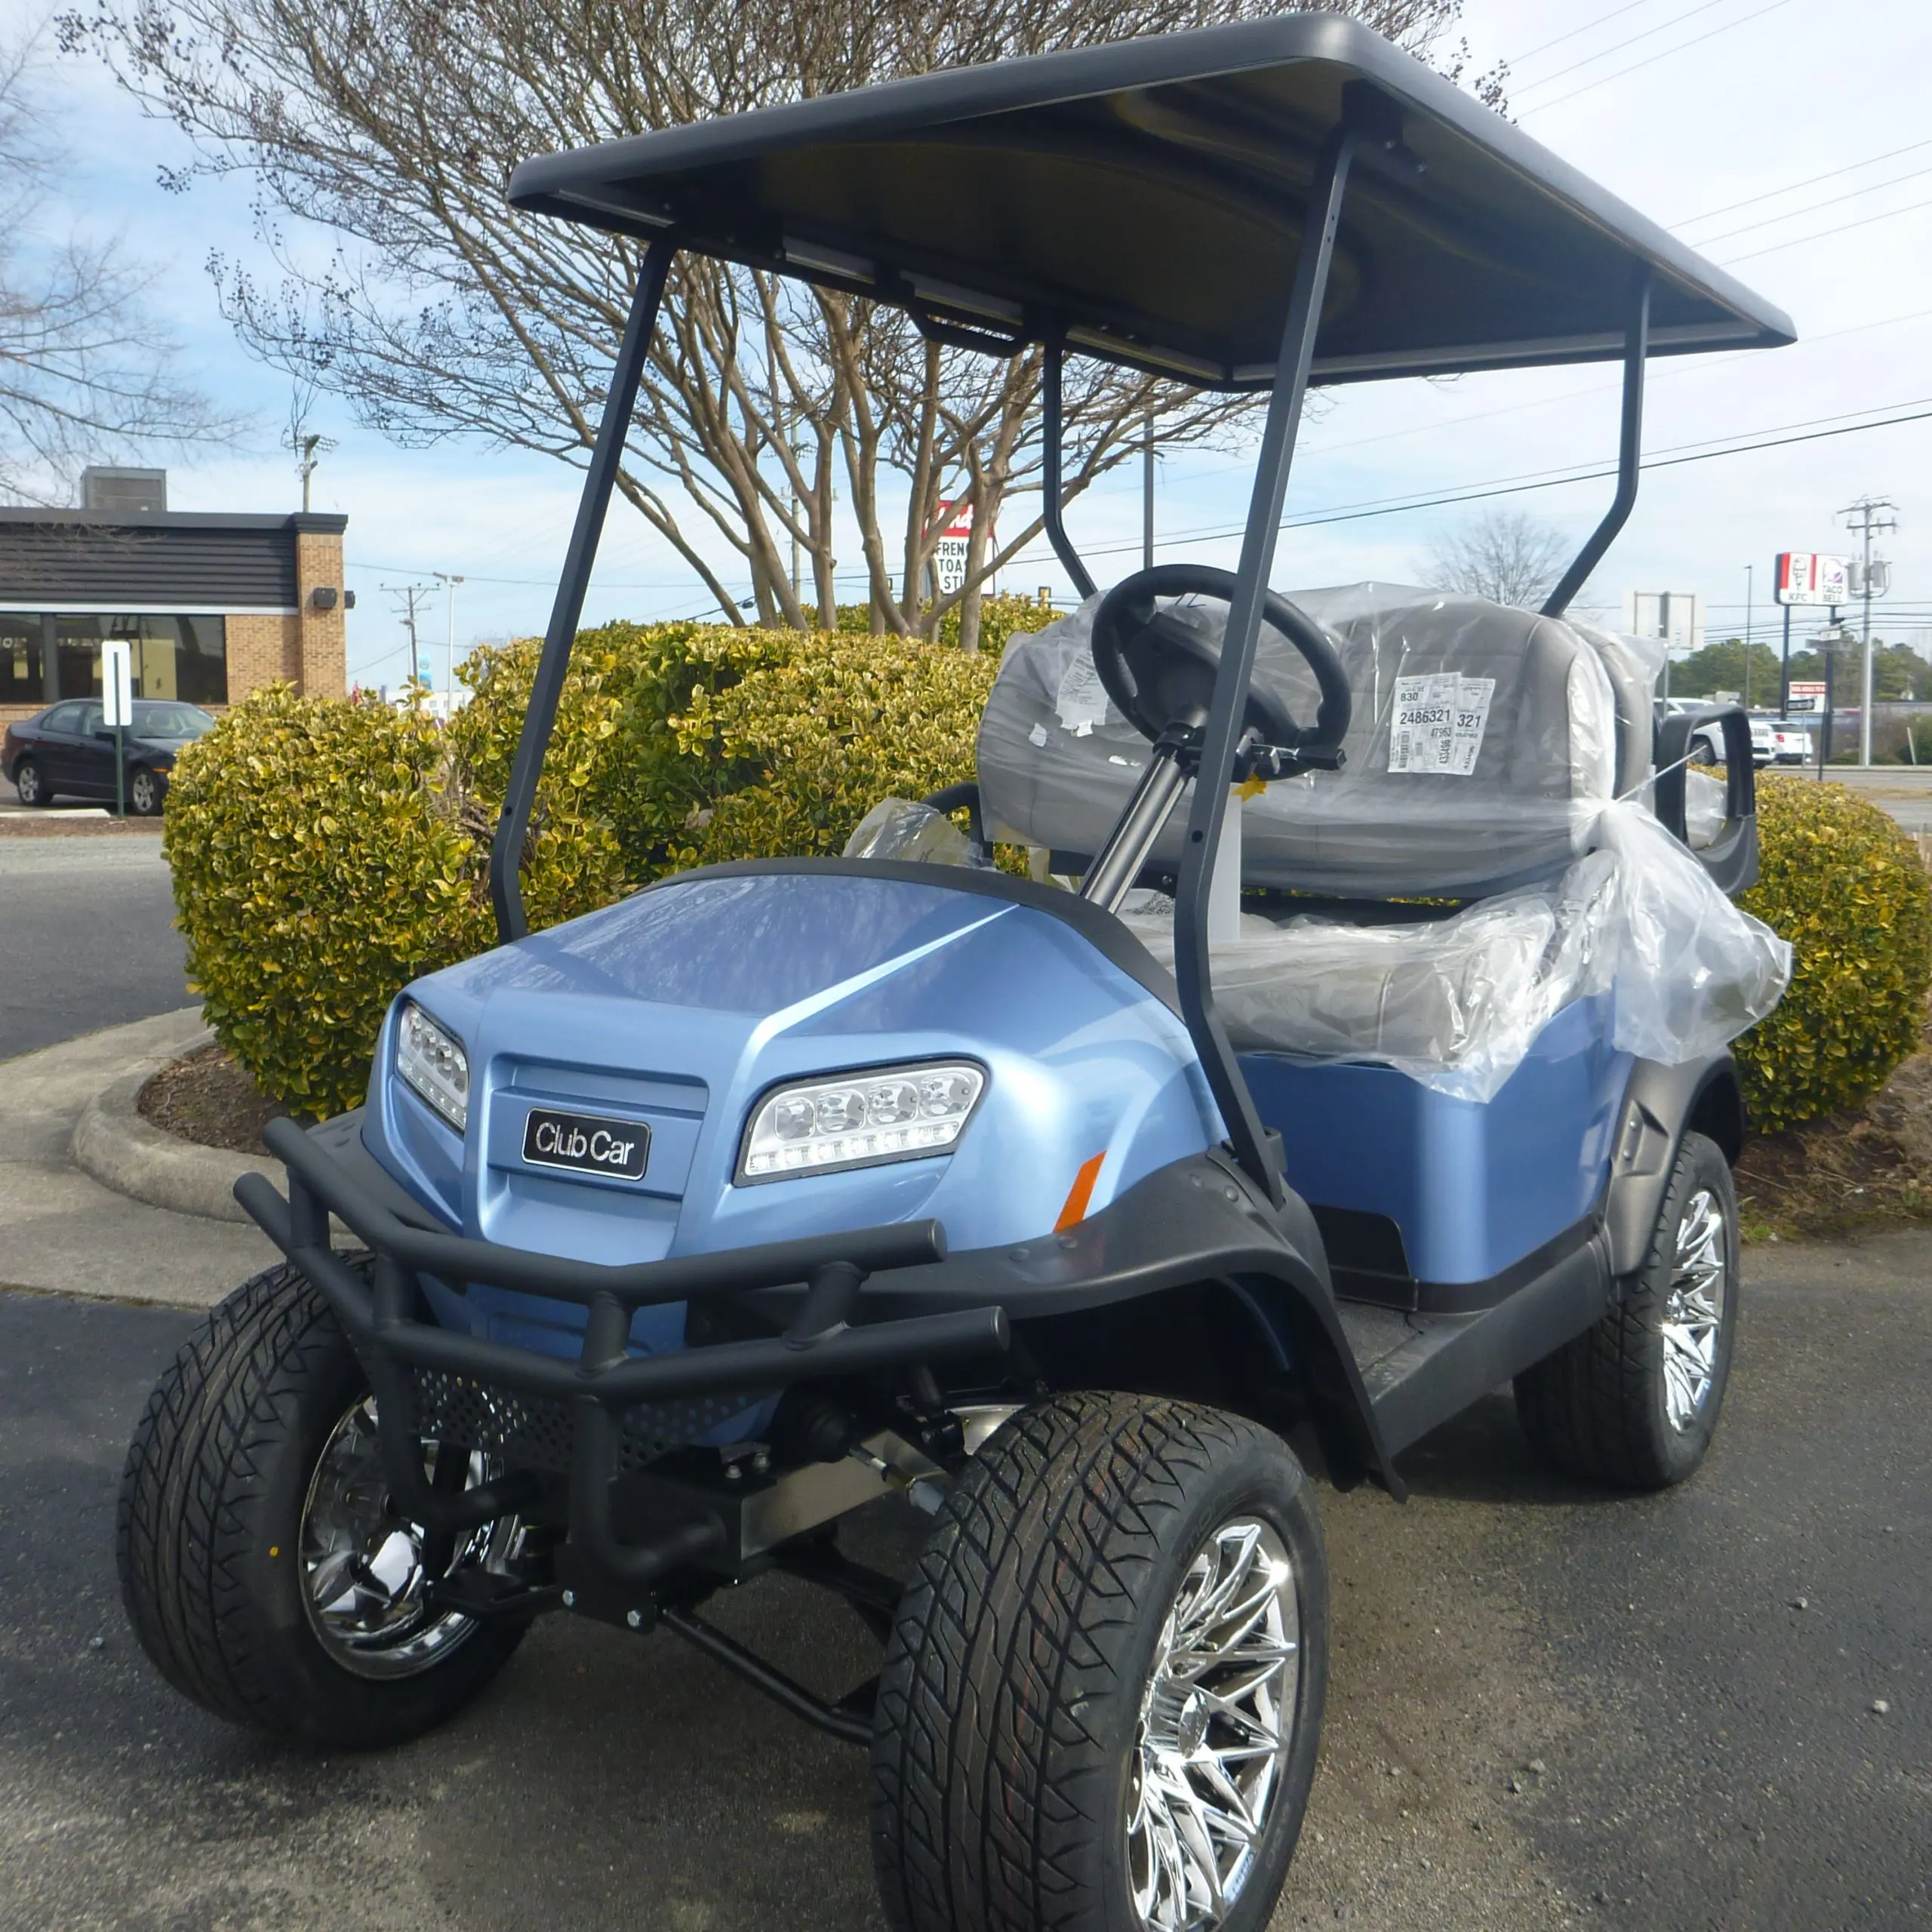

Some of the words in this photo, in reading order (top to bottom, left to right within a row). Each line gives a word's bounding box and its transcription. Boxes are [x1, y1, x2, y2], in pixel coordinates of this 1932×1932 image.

[937, 542, 968, 555] FREN
[939, 559, 965, 572] TOA
[1822, 585, 1843, 593] TACO
[1788, 593, 1807, 601] KFC
[1823, 594, 1842, 603] BELL
[1400, 692, 1418, 702] 830
[1400, 709, 1450, 724] 2486321
[1457, 714, 1481, 728] 321
[536, 1122, 587, 1158] Club
[590, 1131, 634, 1164] Car
